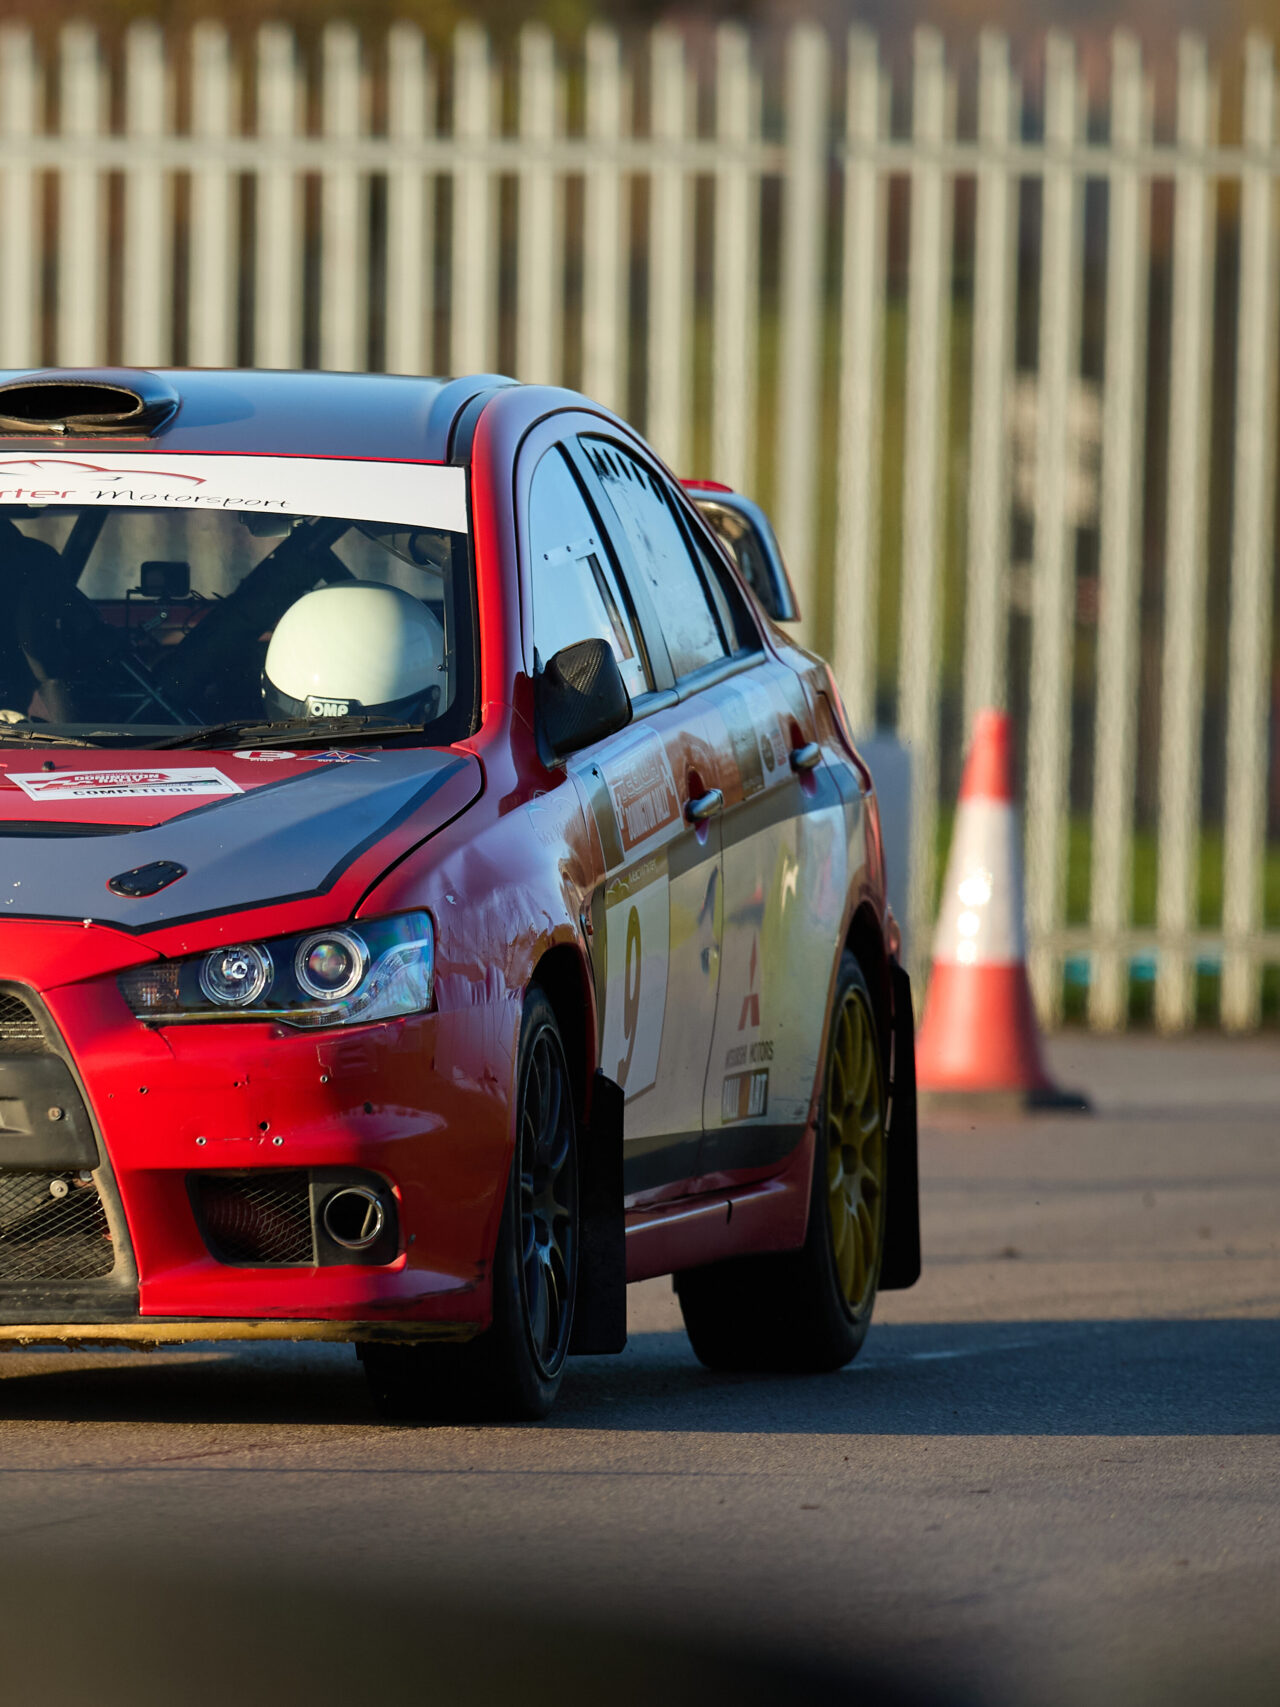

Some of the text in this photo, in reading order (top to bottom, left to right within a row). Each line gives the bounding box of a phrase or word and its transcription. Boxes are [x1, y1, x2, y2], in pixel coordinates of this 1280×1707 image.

[90, 489, 292, 509] Motorsport
[310, 702, 349, 717] OMP
[73, 787, 195, 796] COMPETITOR
[616, 905, 642, 1089] 9
